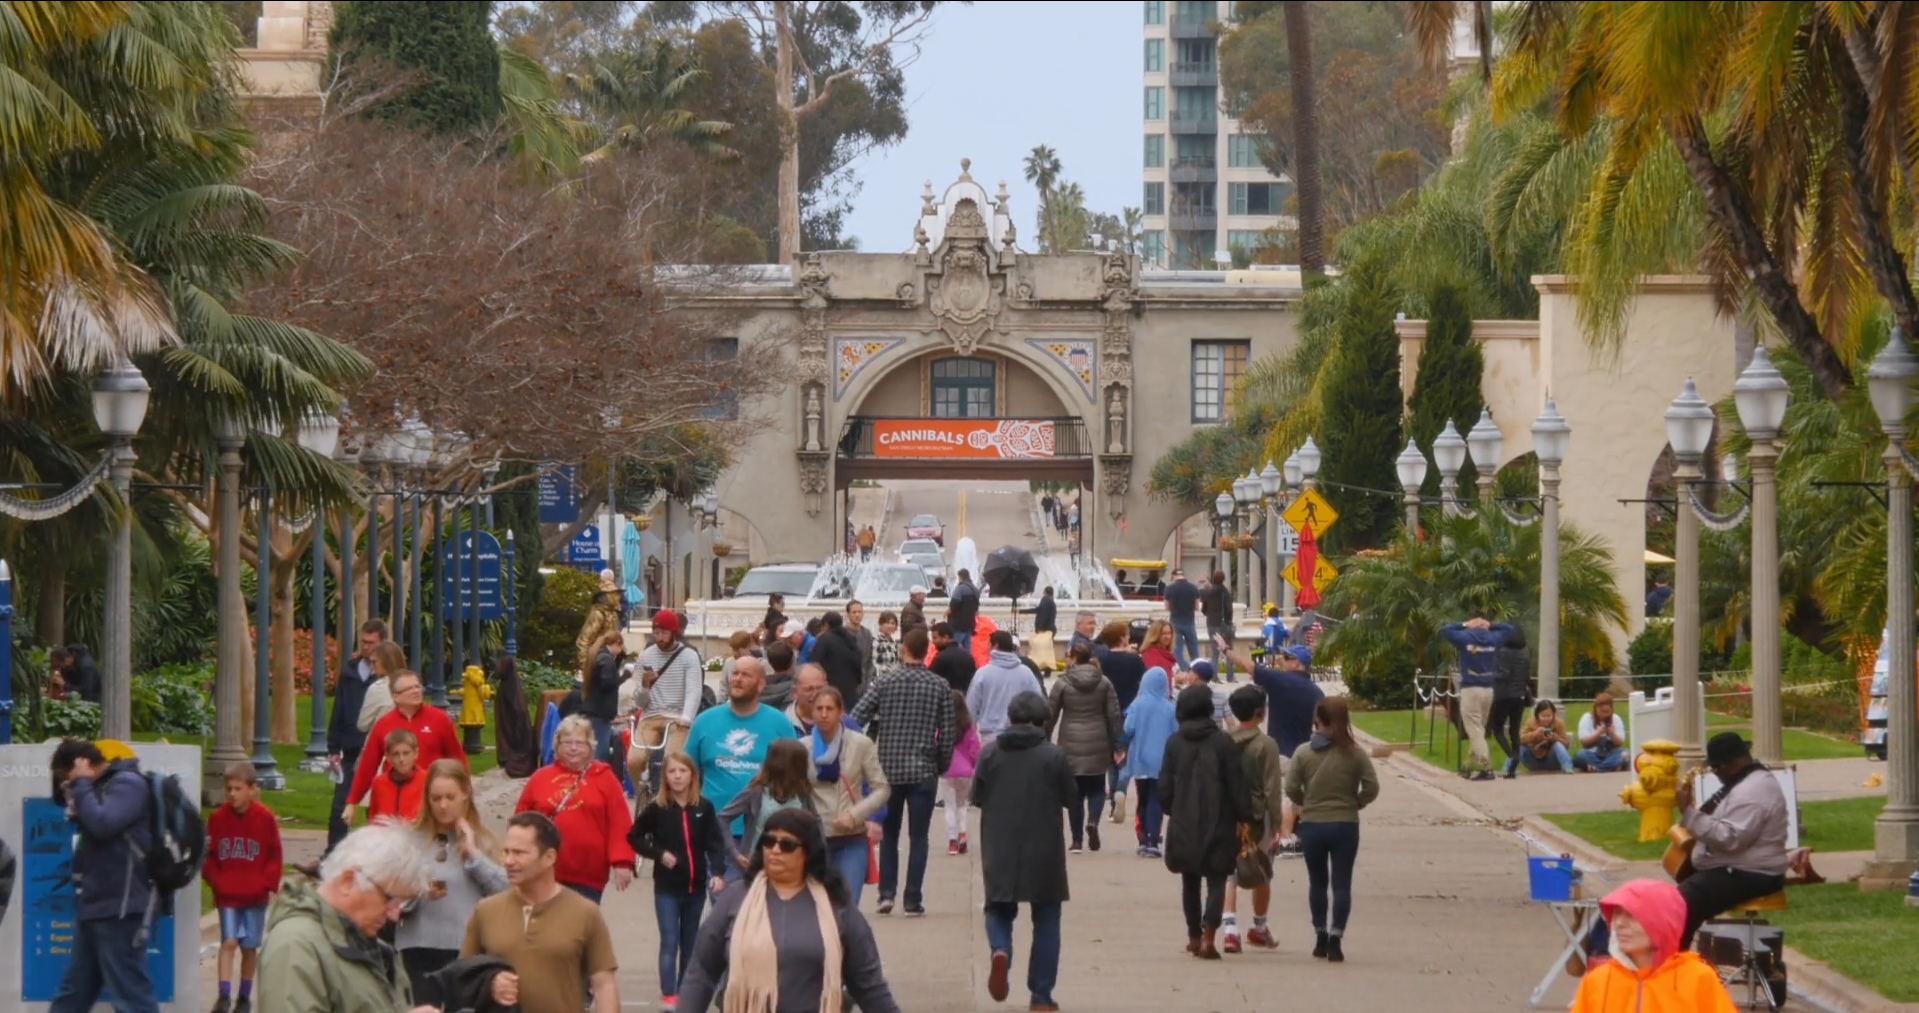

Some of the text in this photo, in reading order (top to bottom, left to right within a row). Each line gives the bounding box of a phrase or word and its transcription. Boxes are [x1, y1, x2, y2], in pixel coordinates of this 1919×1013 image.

[879, 430, 964, 445] CANNIBALS
[571, 539, 593, 547] House
[1282, 537, 1299, 551] 15
[218, 836, 260, 861] GAP
